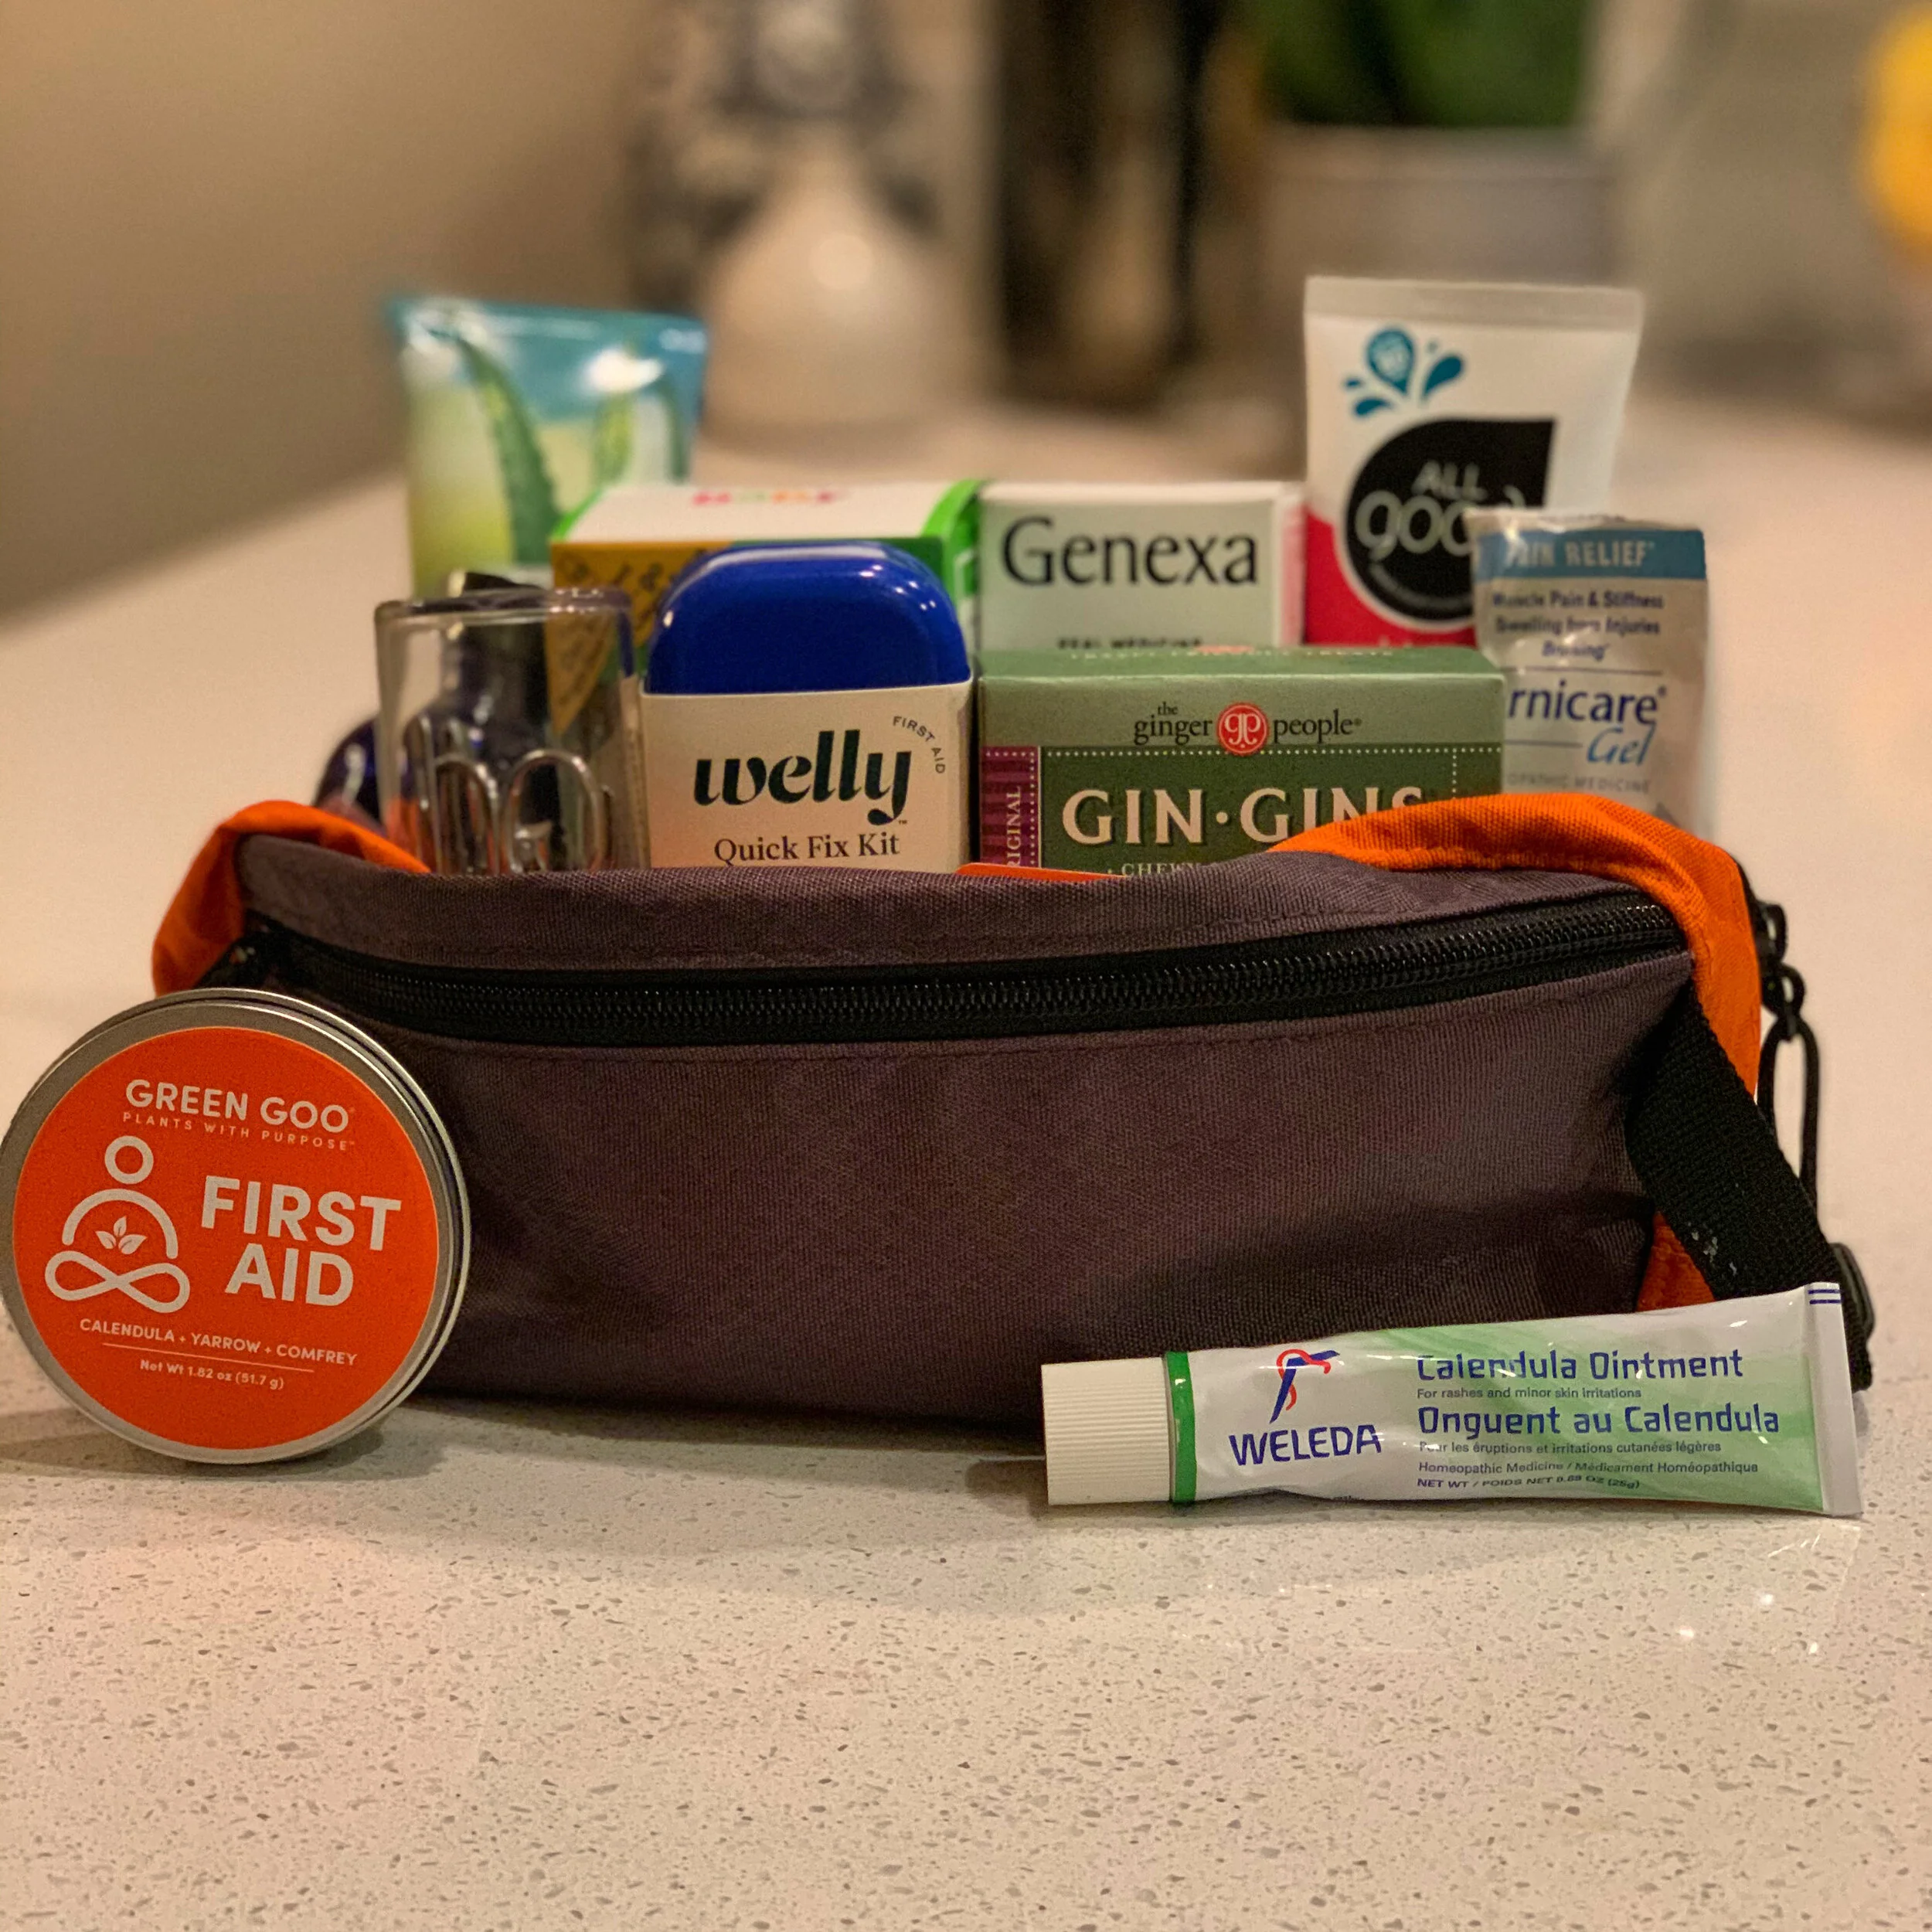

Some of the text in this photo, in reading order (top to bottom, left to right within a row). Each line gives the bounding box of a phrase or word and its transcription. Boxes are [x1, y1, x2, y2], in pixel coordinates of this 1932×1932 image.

[1412, 460, 1488, 501] ALL
[1355, 485, 1527, 562] goo
[1002, 515, 1258, 586] Genexa
[1565, 539, 1646, 566] RELIEF
[1550, 590, 1583, 608] Pain
[1588, 590, 1597, 607] &
[1604, 589, 1665, 609] Stiffness
[1605, 616, 1660, 637] Injuries
[1158, 701, 1179, 716] the
[1508, 679, 1658, 725] rnicare
[893, 716, 946, 774] FIRST AID
[1134, 715, 1213, 746] ginger
[1273, 708, 1354, 744] people
[1587, 722, 1657, 766] Gel
[694, 729, 912, 826] welly
[1006, 785, 1022, 866] RIGINAL
[714, 831, 900, 866] Quick Fix Kit
[125, 1079, 349, 1134] GREEN GOO
[123, 1111, 347, 1151] PLANTS WITH PURPOSE
[200, 1175, 402, 1251] FIRST
[224, 1243, 355, 1306] AID
[80, 1318, 175, 1342] CALENDULA
[191, 1332, 261, 1354] YARROW
[276, 1343, 358, 1366] COMFREY
[140, 1359, 285, 1390] Net Wt 1.82 oz (51.7 g)
[1417, 1349, 1743, 1381] Calendula Ointment
[1417, 1386, 1642, 1400] For rashes and minor skin irritations
[1418, 1402, 1779, 1440] Onguent au Calendula
[1228, 1423, 1382, 1467] WELEDA
[1451, 1441, 1470, 1453] les
[1473, 1440, 1532, 1455] éruptions
[1536, 1444, 1549, 1454] et
[1553, 1441, 1613, 1454] irritations
[1616, 1440, 1672, 1453] cutanées
[1675, 1439, 1722, 1454] légères
[1417, 1478, 1444, 1488] NET
[1482, 1478, 1522, 1486] POIDS
[1526, 1477, 1554, 1485] NET
[1419, 1461, 1502, 1475] Homeopathic
[1507, 1461, 1564, 1472] Medicine
[1574, 1462, 1655, 1472] Médicament
[1658, 1461, 1758, 1475] Homéopathique
